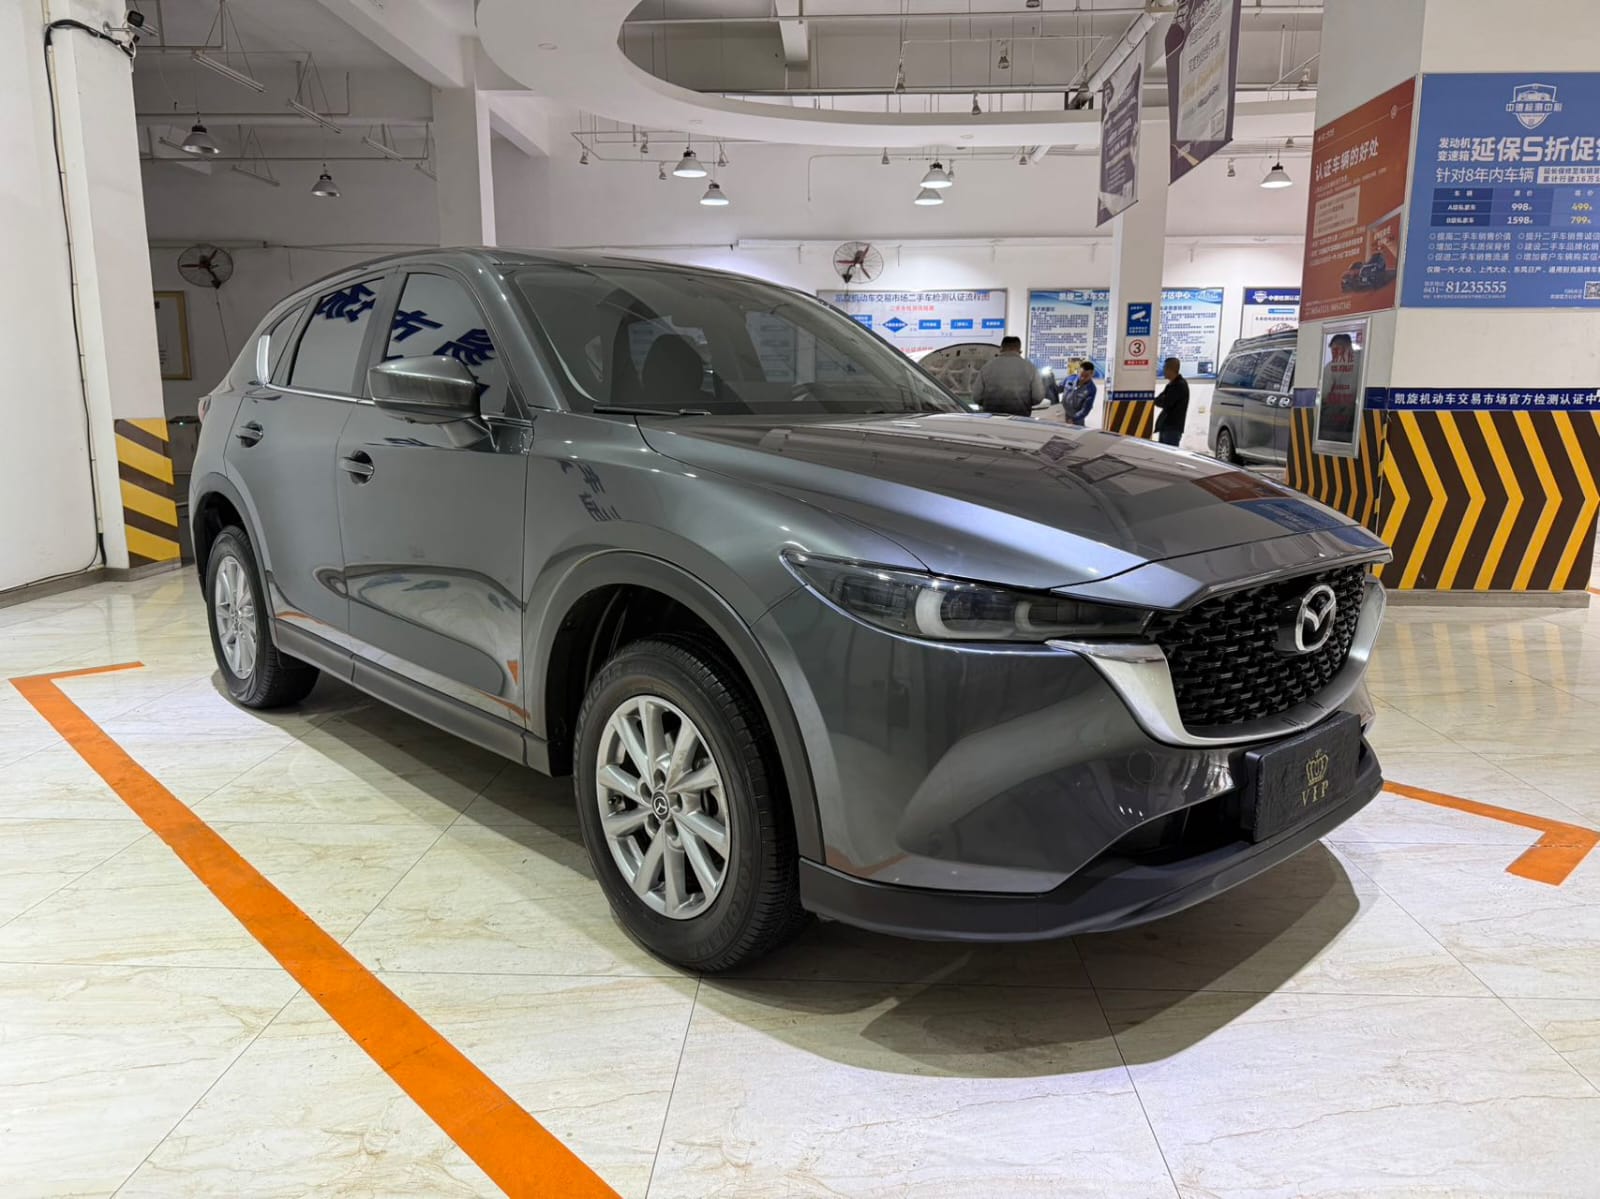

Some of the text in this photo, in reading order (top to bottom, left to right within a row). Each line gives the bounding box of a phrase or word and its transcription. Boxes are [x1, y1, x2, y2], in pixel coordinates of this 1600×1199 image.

[1439, 137, 1471, 149] 发动机
[1471, 136, 1600, 162] 延保5折促
[1316, 136, 1379, 182] 认证车辆的好处
[1437, 150, 1470, 162] 变速箱
[1436, 167, 1534, 183] 针对8年内车辆
[1446, 281, 1507, 294] 81235555
[1394, 392, 1600, 405] 凯旋机动车交易市场官方检测认证中
[1302, 780, 1329, 806] VIP
